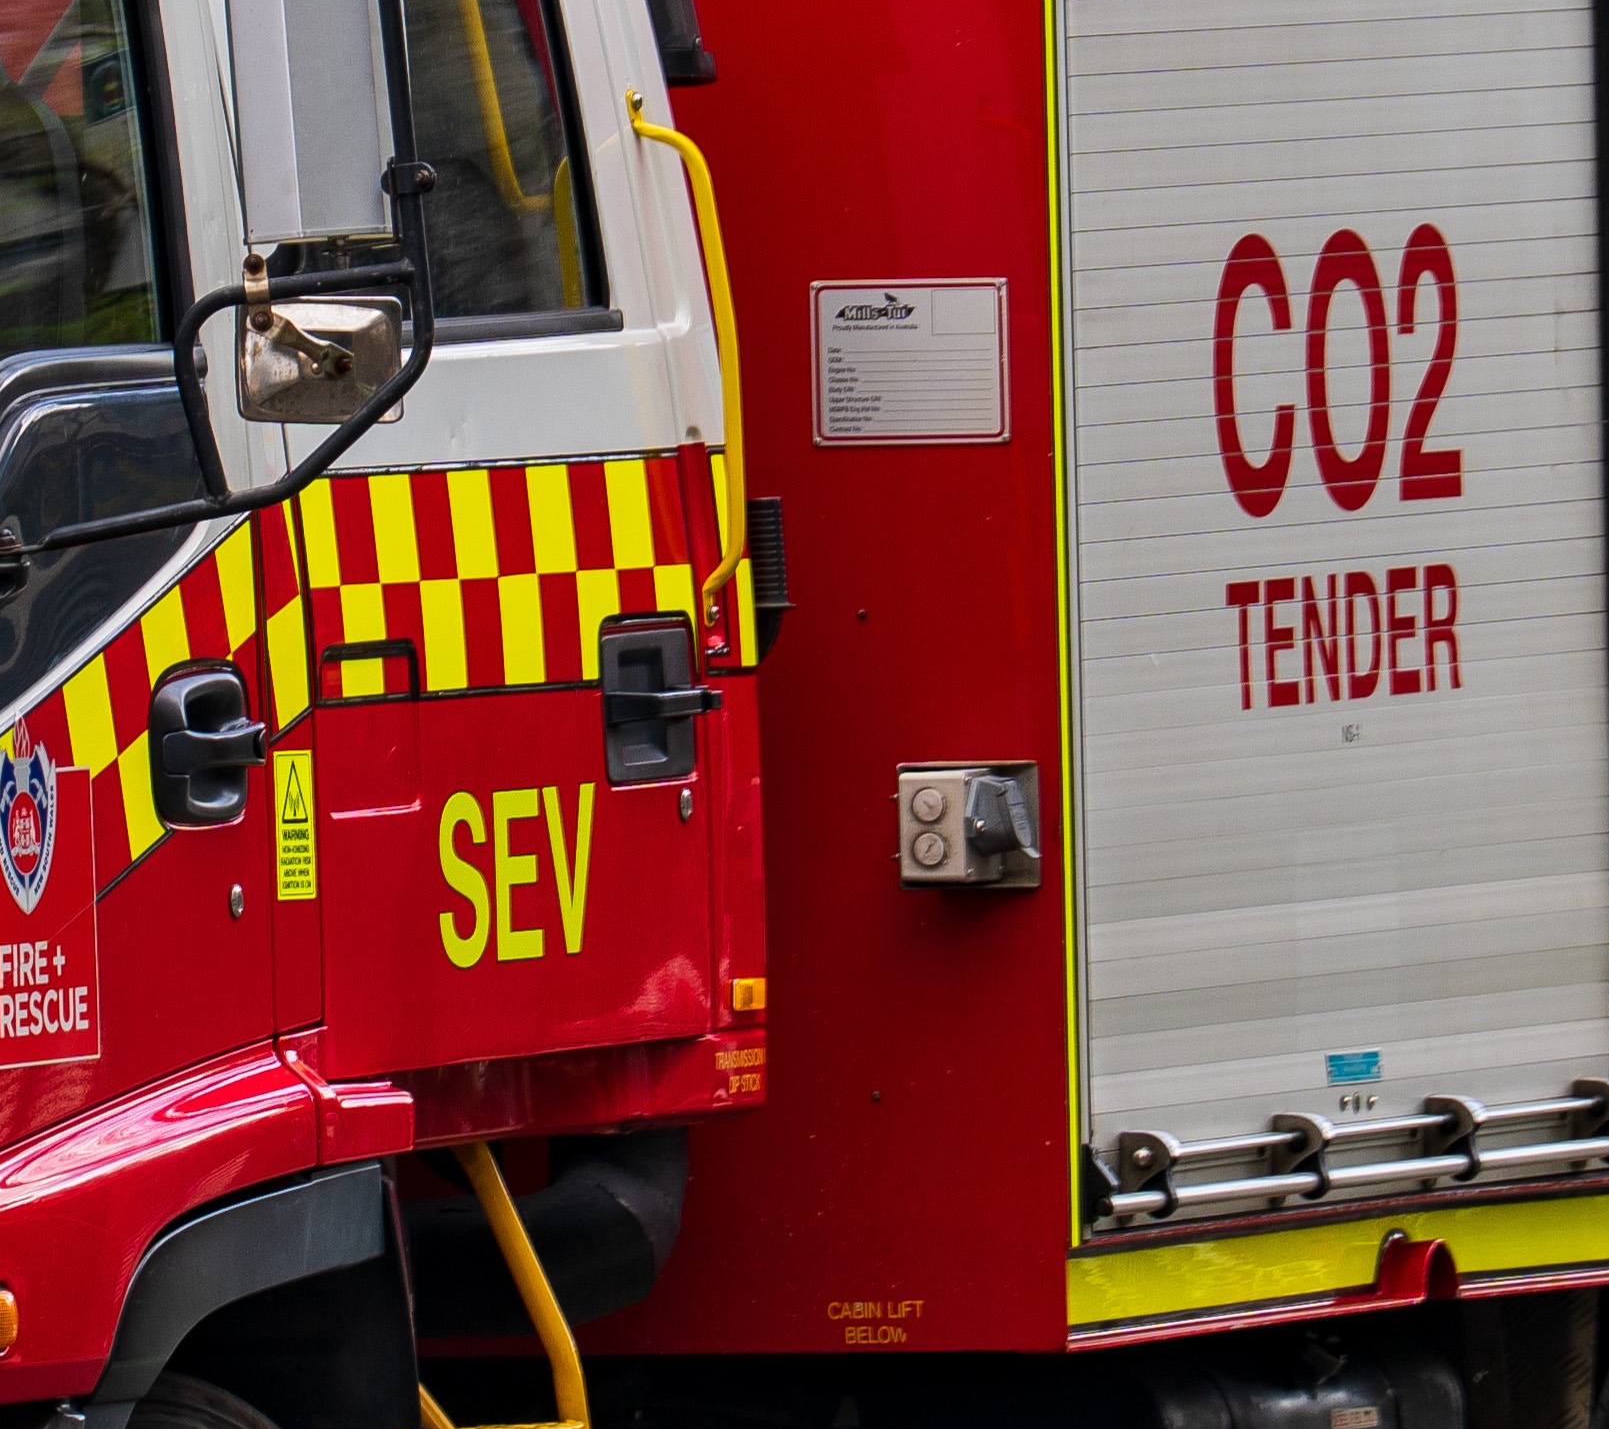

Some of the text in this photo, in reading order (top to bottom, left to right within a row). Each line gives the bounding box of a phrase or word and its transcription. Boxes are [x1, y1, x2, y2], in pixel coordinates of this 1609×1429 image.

[1213, 222, 1465, 519] CO2
[1226, 562, 1464, 711] TENDER
[438, 781, 595, 970] SEV
[0, 985, 89, 1039] RESCUE
[715, 1048, 766, 1071] TRANSMISSION
[827, 1300, 925, 1321] CABIN LIFT
[845, 1326, 907, 1344] BELOW
